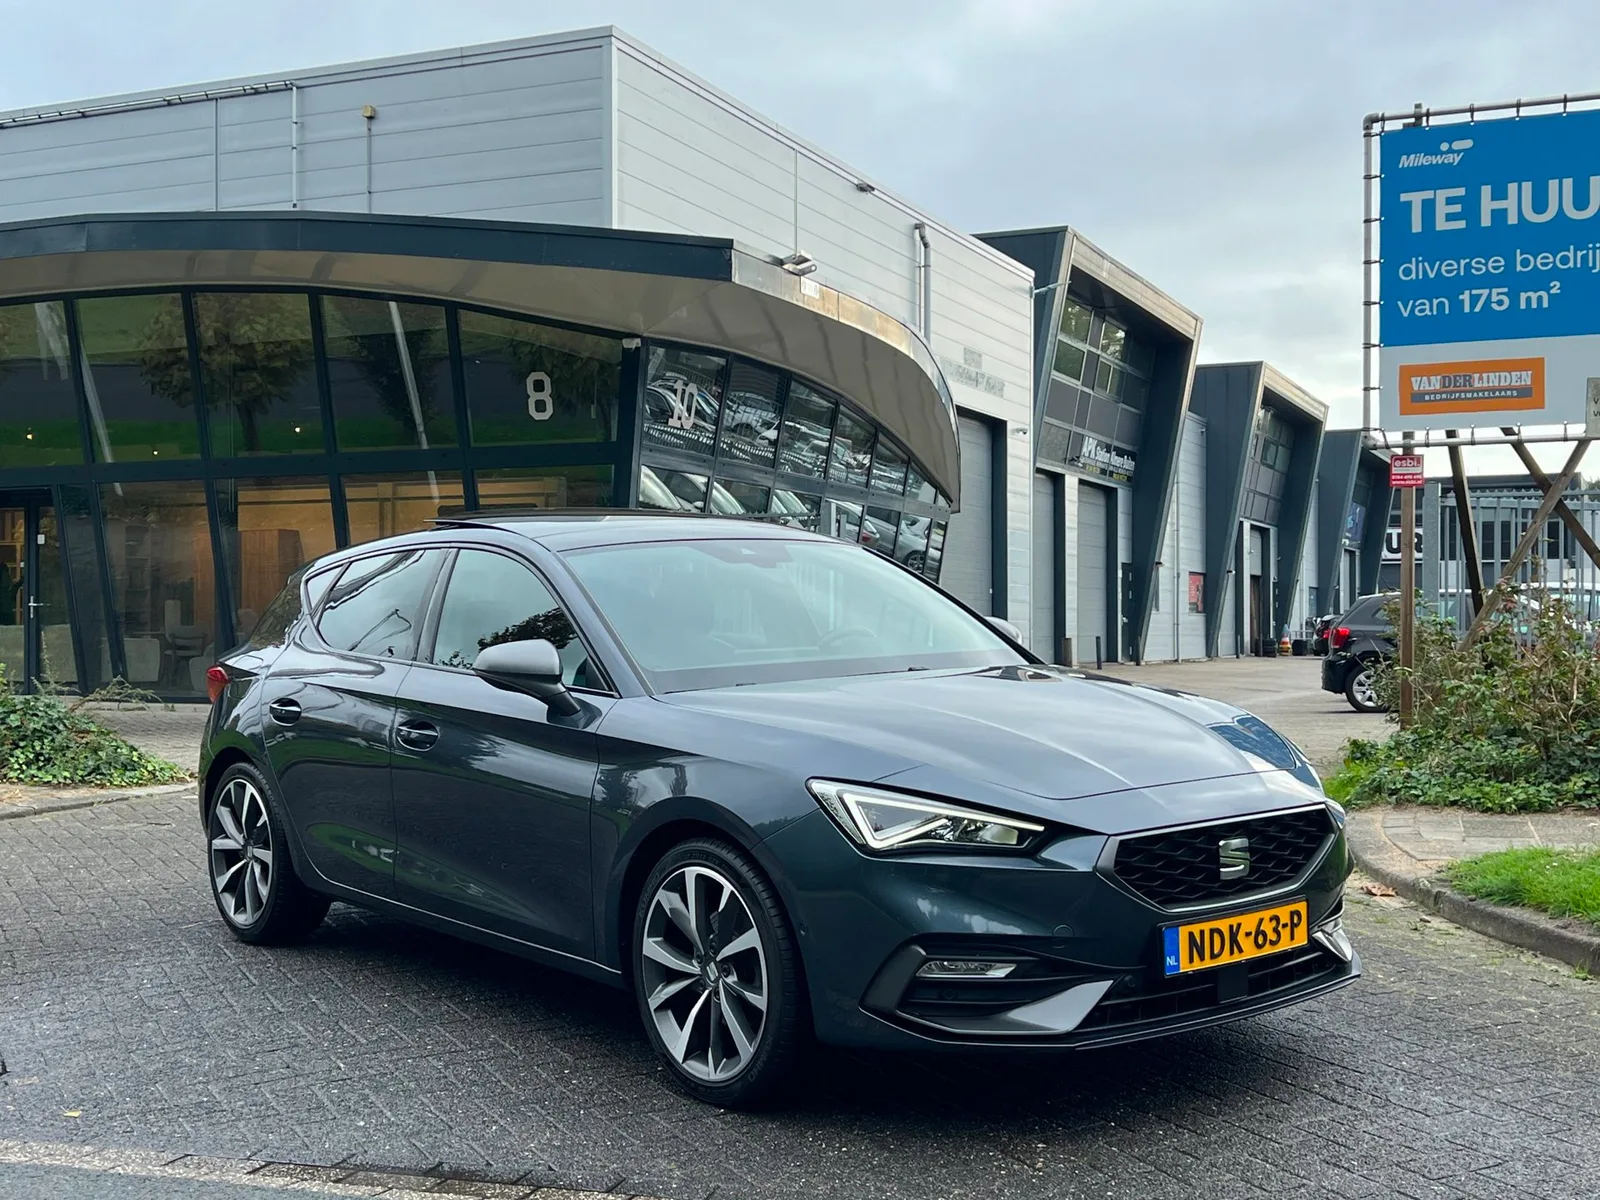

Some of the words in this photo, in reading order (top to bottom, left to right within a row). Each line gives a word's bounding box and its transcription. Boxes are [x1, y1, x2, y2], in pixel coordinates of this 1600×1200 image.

[1398, 152, 1464, 169] Mileway
[1400, 187, 1466, 233] TE
[1398, 255, 1505, 281] diverse
[1397, 296, 1450, 318] van
[1459, 287, 1510, 313] 175
[526, 371, 554, 421] 8
[668, 379, 698, 430] 10
[1424, 390, 1518, 401] BEDRIJFSMAKELAARS
[1187, 909, 1302, 964] NDK-63-P
[1166, 955, 1178, 966] NL
